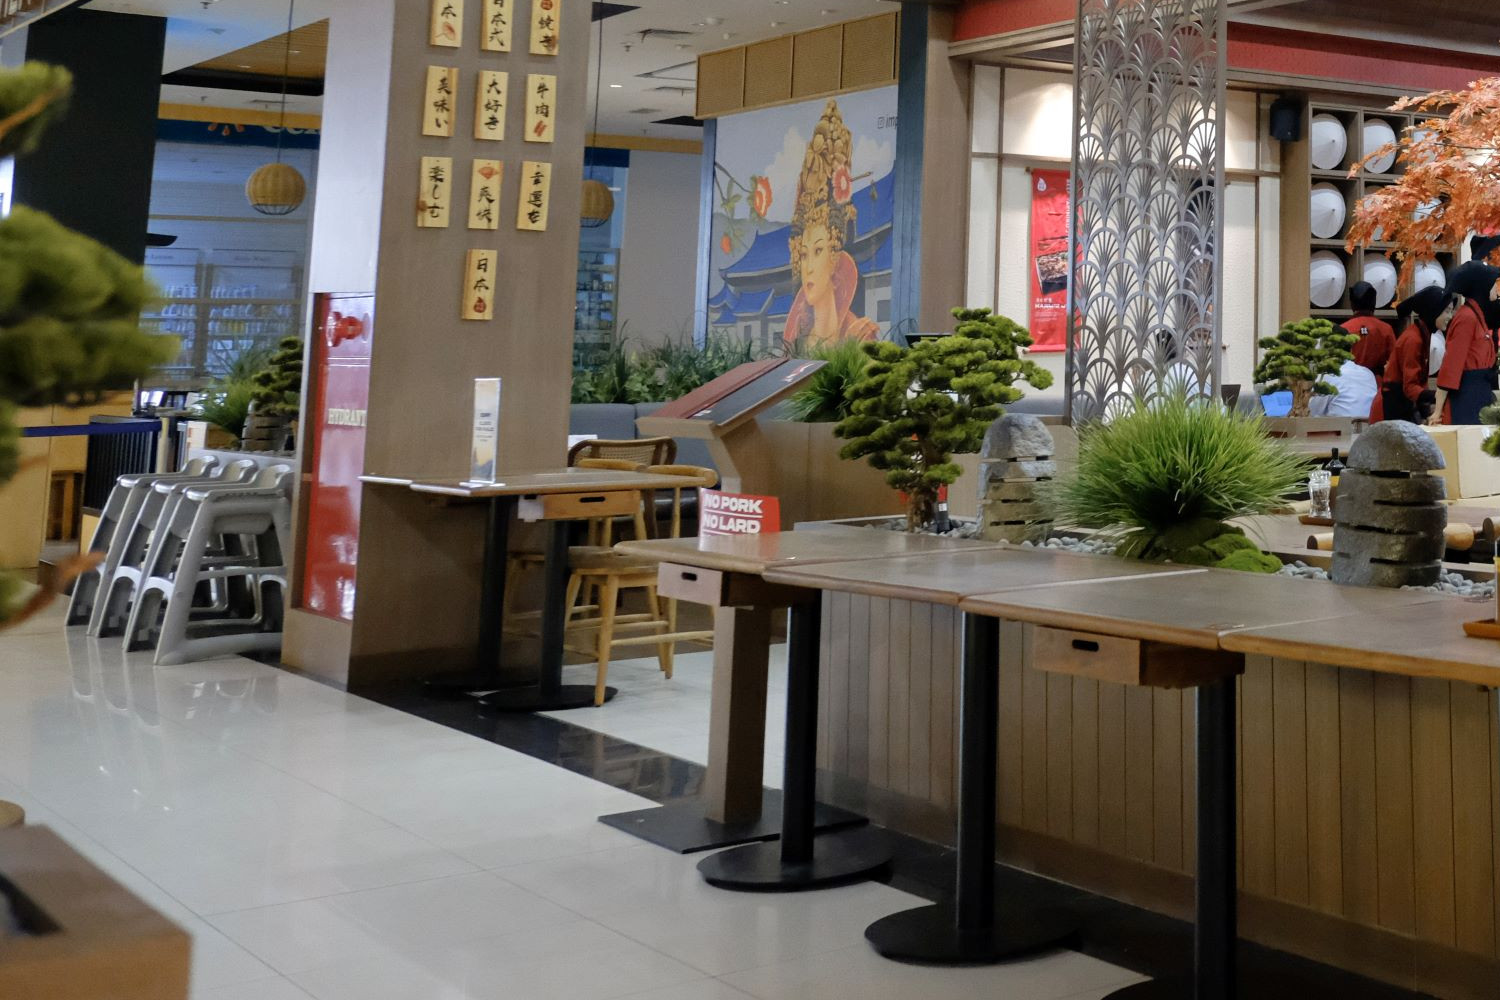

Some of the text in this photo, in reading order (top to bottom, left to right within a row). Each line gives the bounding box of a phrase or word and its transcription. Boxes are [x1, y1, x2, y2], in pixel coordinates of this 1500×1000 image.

[484, 79, 503, 130] 大好き
[535, 82, 550, 118] 牛肉
[473, 258, 489, 293] 日本
[328, 408, 367, 427] HYDRANT
[703, 493, 763, 514] NO PORK
[703, 513, 761, 534] NO LARD
